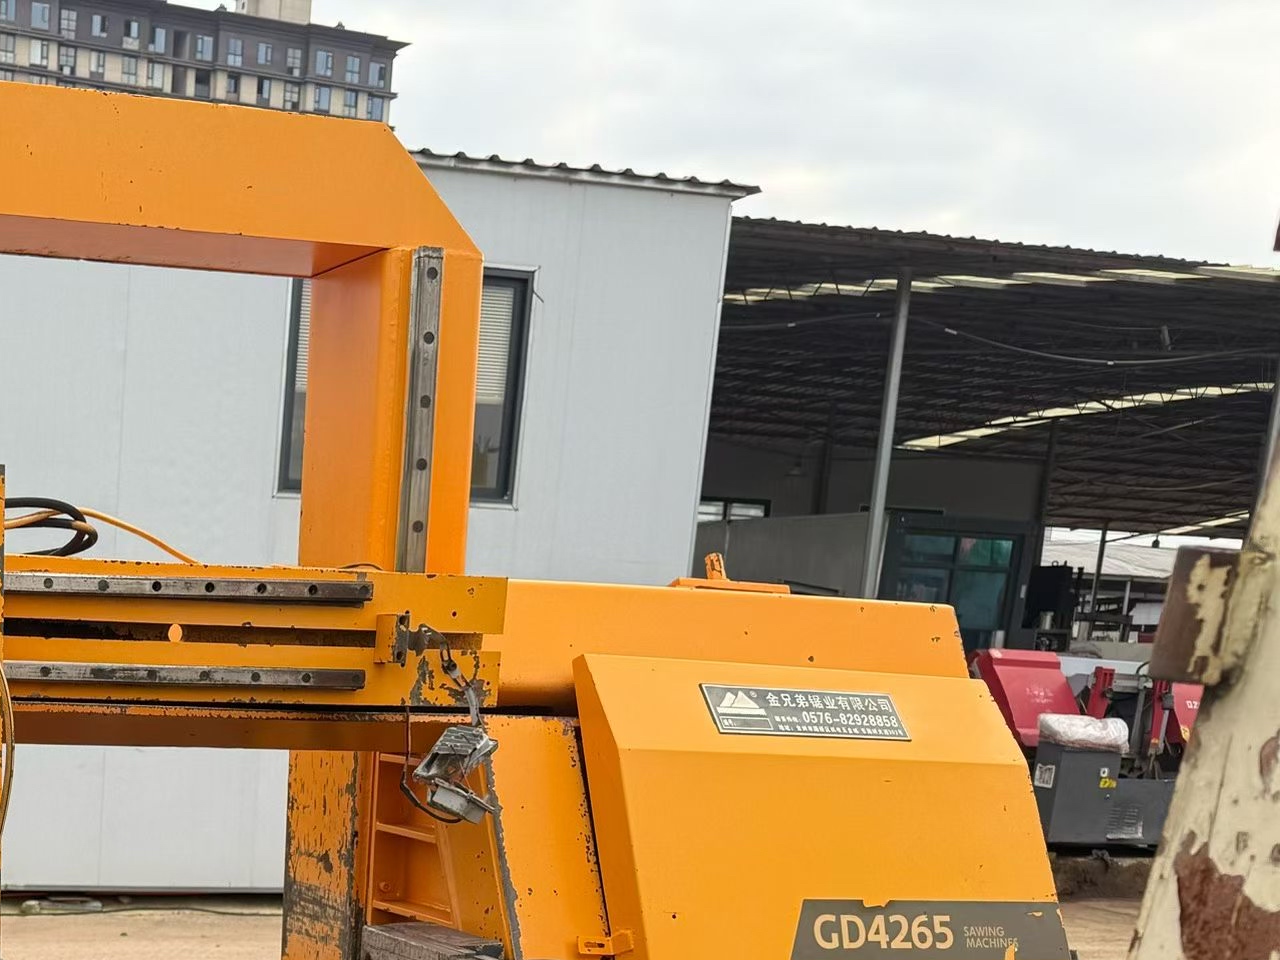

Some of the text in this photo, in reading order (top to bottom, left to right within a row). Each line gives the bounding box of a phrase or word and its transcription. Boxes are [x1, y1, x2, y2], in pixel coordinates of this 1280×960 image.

[766, 692, 892, 712] 金兄弟锯业有限公司
[802, 711, 899, 728] 0576-82928858
[813, 914, 954, 950] GD4265
[963, 926, 1005, 937] SAWING
